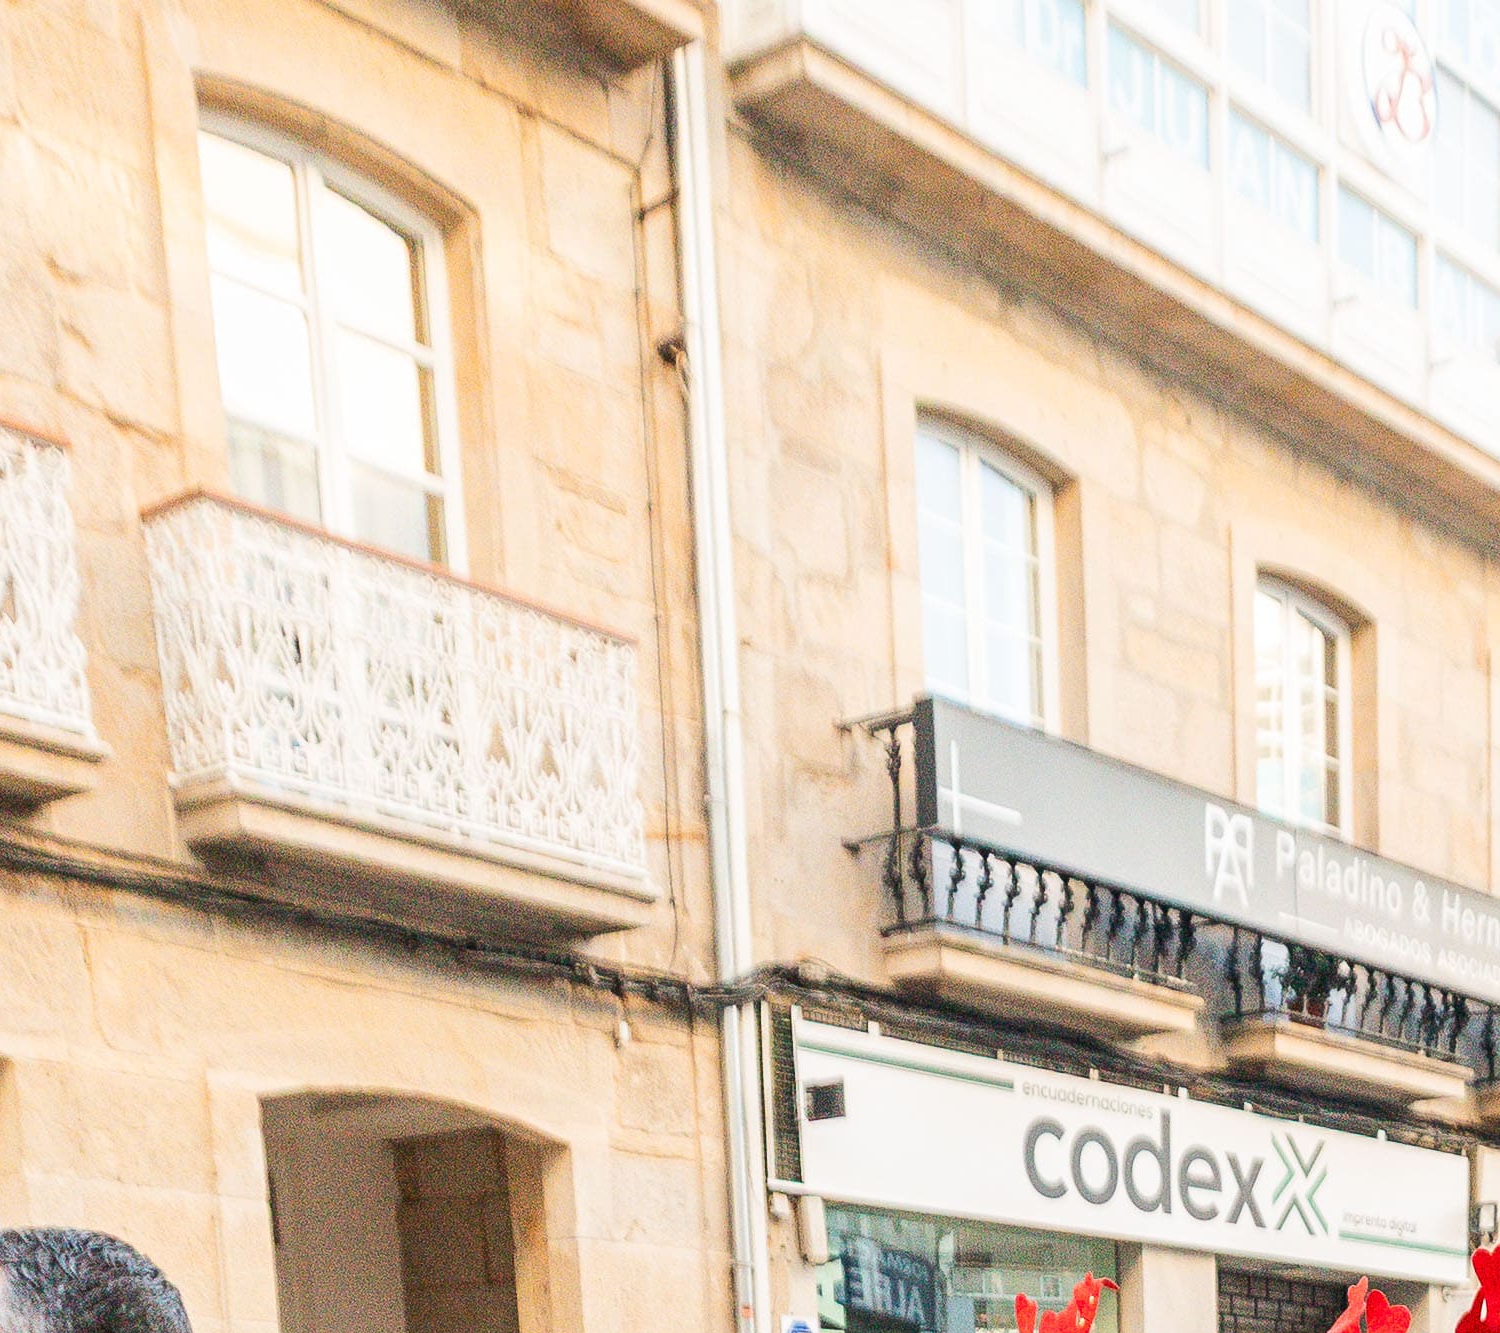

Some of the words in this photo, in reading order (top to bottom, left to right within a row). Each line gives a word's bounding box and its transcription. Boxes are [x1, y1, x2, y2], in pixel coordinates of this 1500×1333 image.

[1276, 828, 1402, 915] Paladino
[1413, 880, 1432, 923] &
[1343, 917, 1433, 965] ABOGADOS
[1022, 1081, 1154, 1120] encuadernaciones
